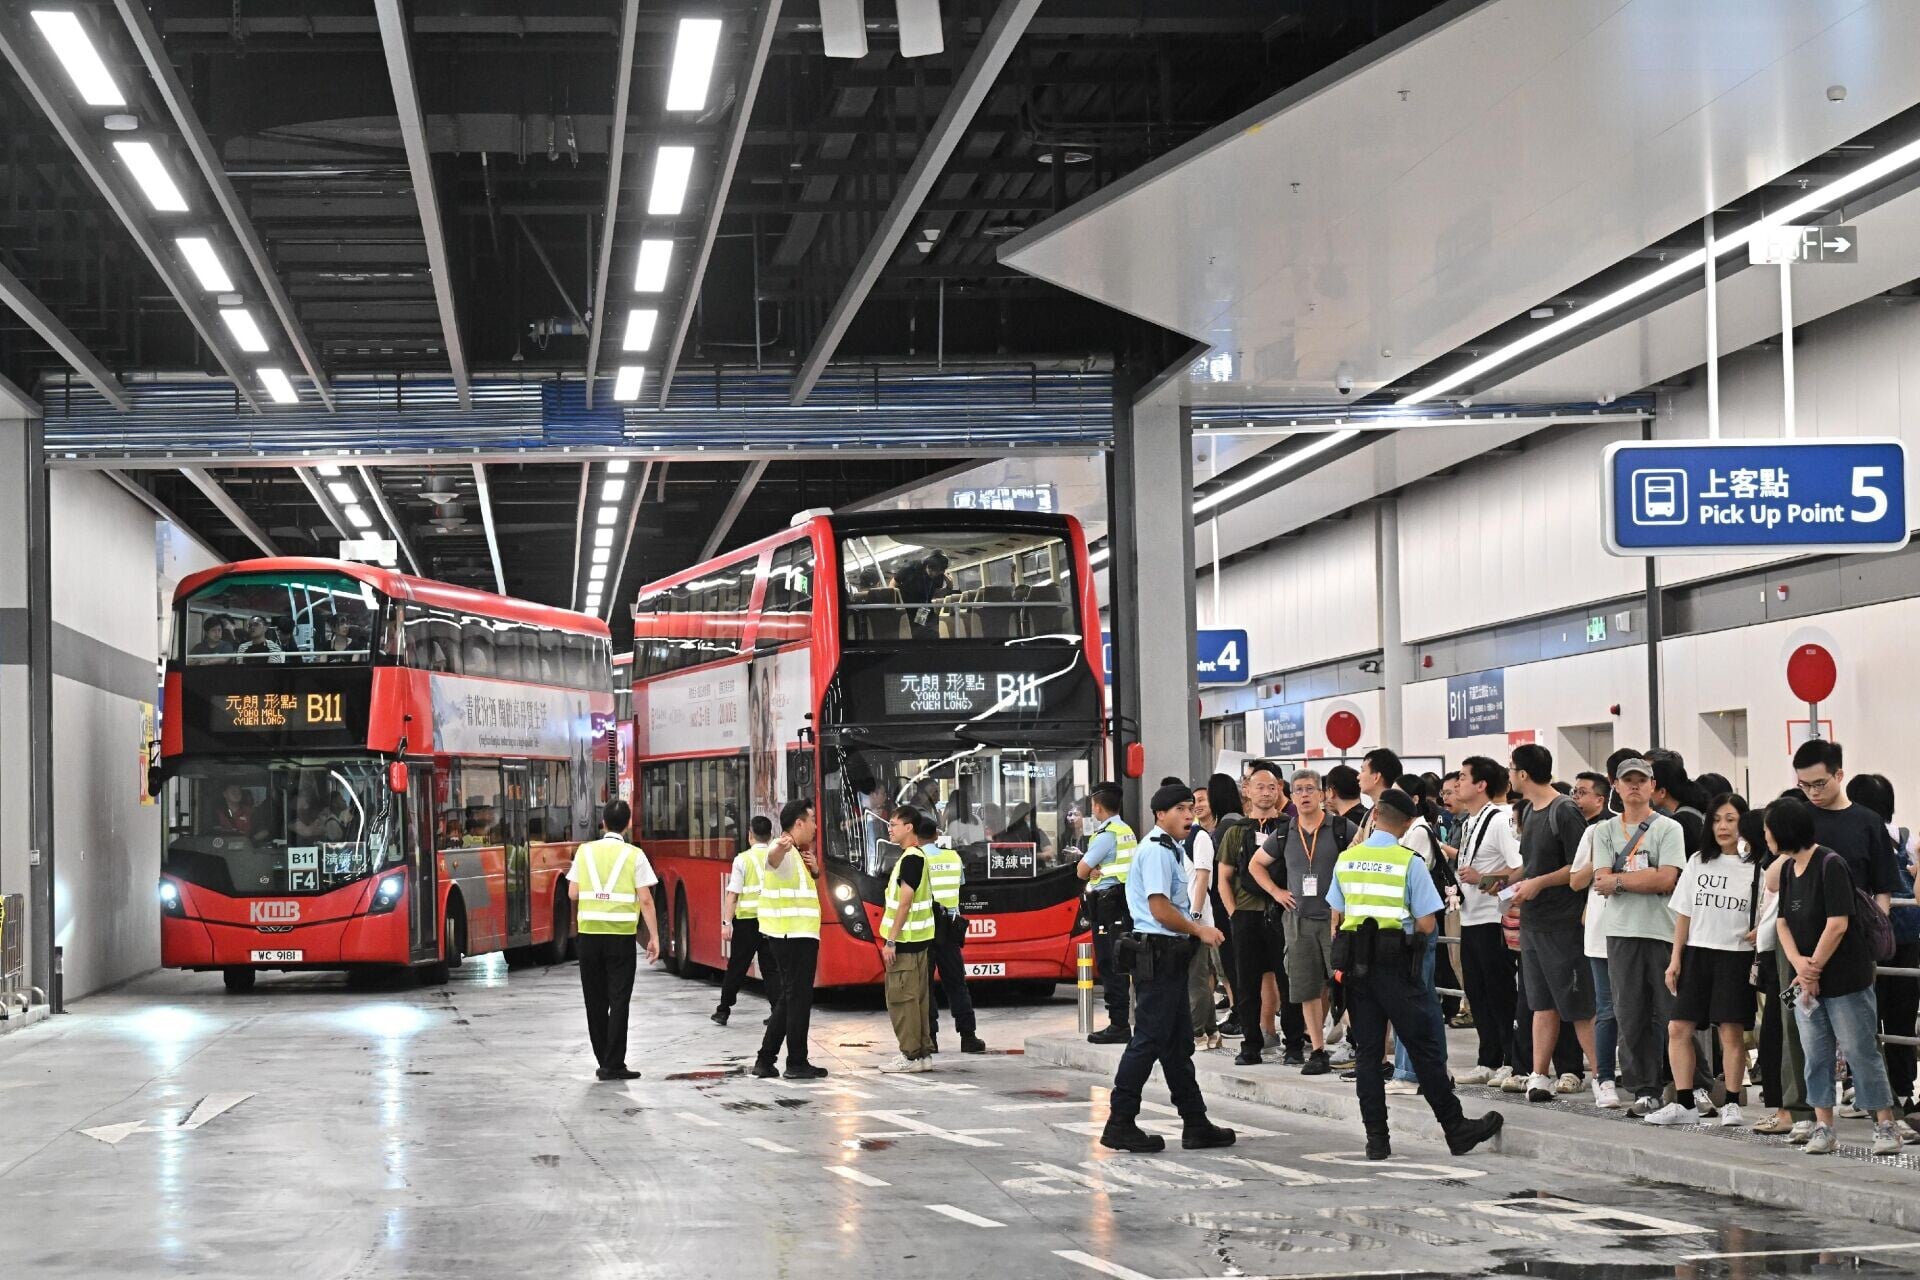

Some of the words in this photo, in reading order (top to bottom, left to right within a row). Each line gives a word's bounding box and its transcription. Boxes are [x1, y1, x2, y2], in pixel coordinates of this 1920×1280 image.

[1699, 468, 1790, 499] 上客點
[1700, 504, 1744, 525] Pick
[1751, 505, 1781, 529] Up
[1787, 503, 1845, 523] Point
[1850, 466, 1888, 523] 5
[1217, 640, 1241, 671] 4
[900, 674, 939, 693] 元朗
[945, 673, 985, 691] 形點
[996, 673, 1038, 707] B11
[225, 695, 259, 711] 元朗
[263, 693, 298, 709] 形點
[910, 700, 941, 710] (YUEN
[943, 700, 973, 710] LONG)
[915, 691, 941, 700] YOHO
[943, 691, 969, 700] MALL
[1449, 689, 1467, 721] B11
[237, 708, 259, 717] YOHO
[261, 708, 283, 717] MALL
[307, 693, 342, 722] B11
[233, 717, 259, 726] (YUEN
[261, 716, 286, 725] LONG)
[1264, 719, 1280, 744] NB73
[292, 853, 314, 864] B11
[991, 854, 1033, 870] 演練中
[1356, 861, 1382, 872] POLICE
[292, 871, 316, 890] F4
[1697, 873, 1728, 889] QUI
[1694, 889, 1749, 912] ÉTUDE
[249, 900, 300, 922] KMB
[965, 918, 997, 938] MB
[258, 951, 272, 961] WC
[276, 951, 296, 961] 9181
[972, 964, 1001, 975] 6713
